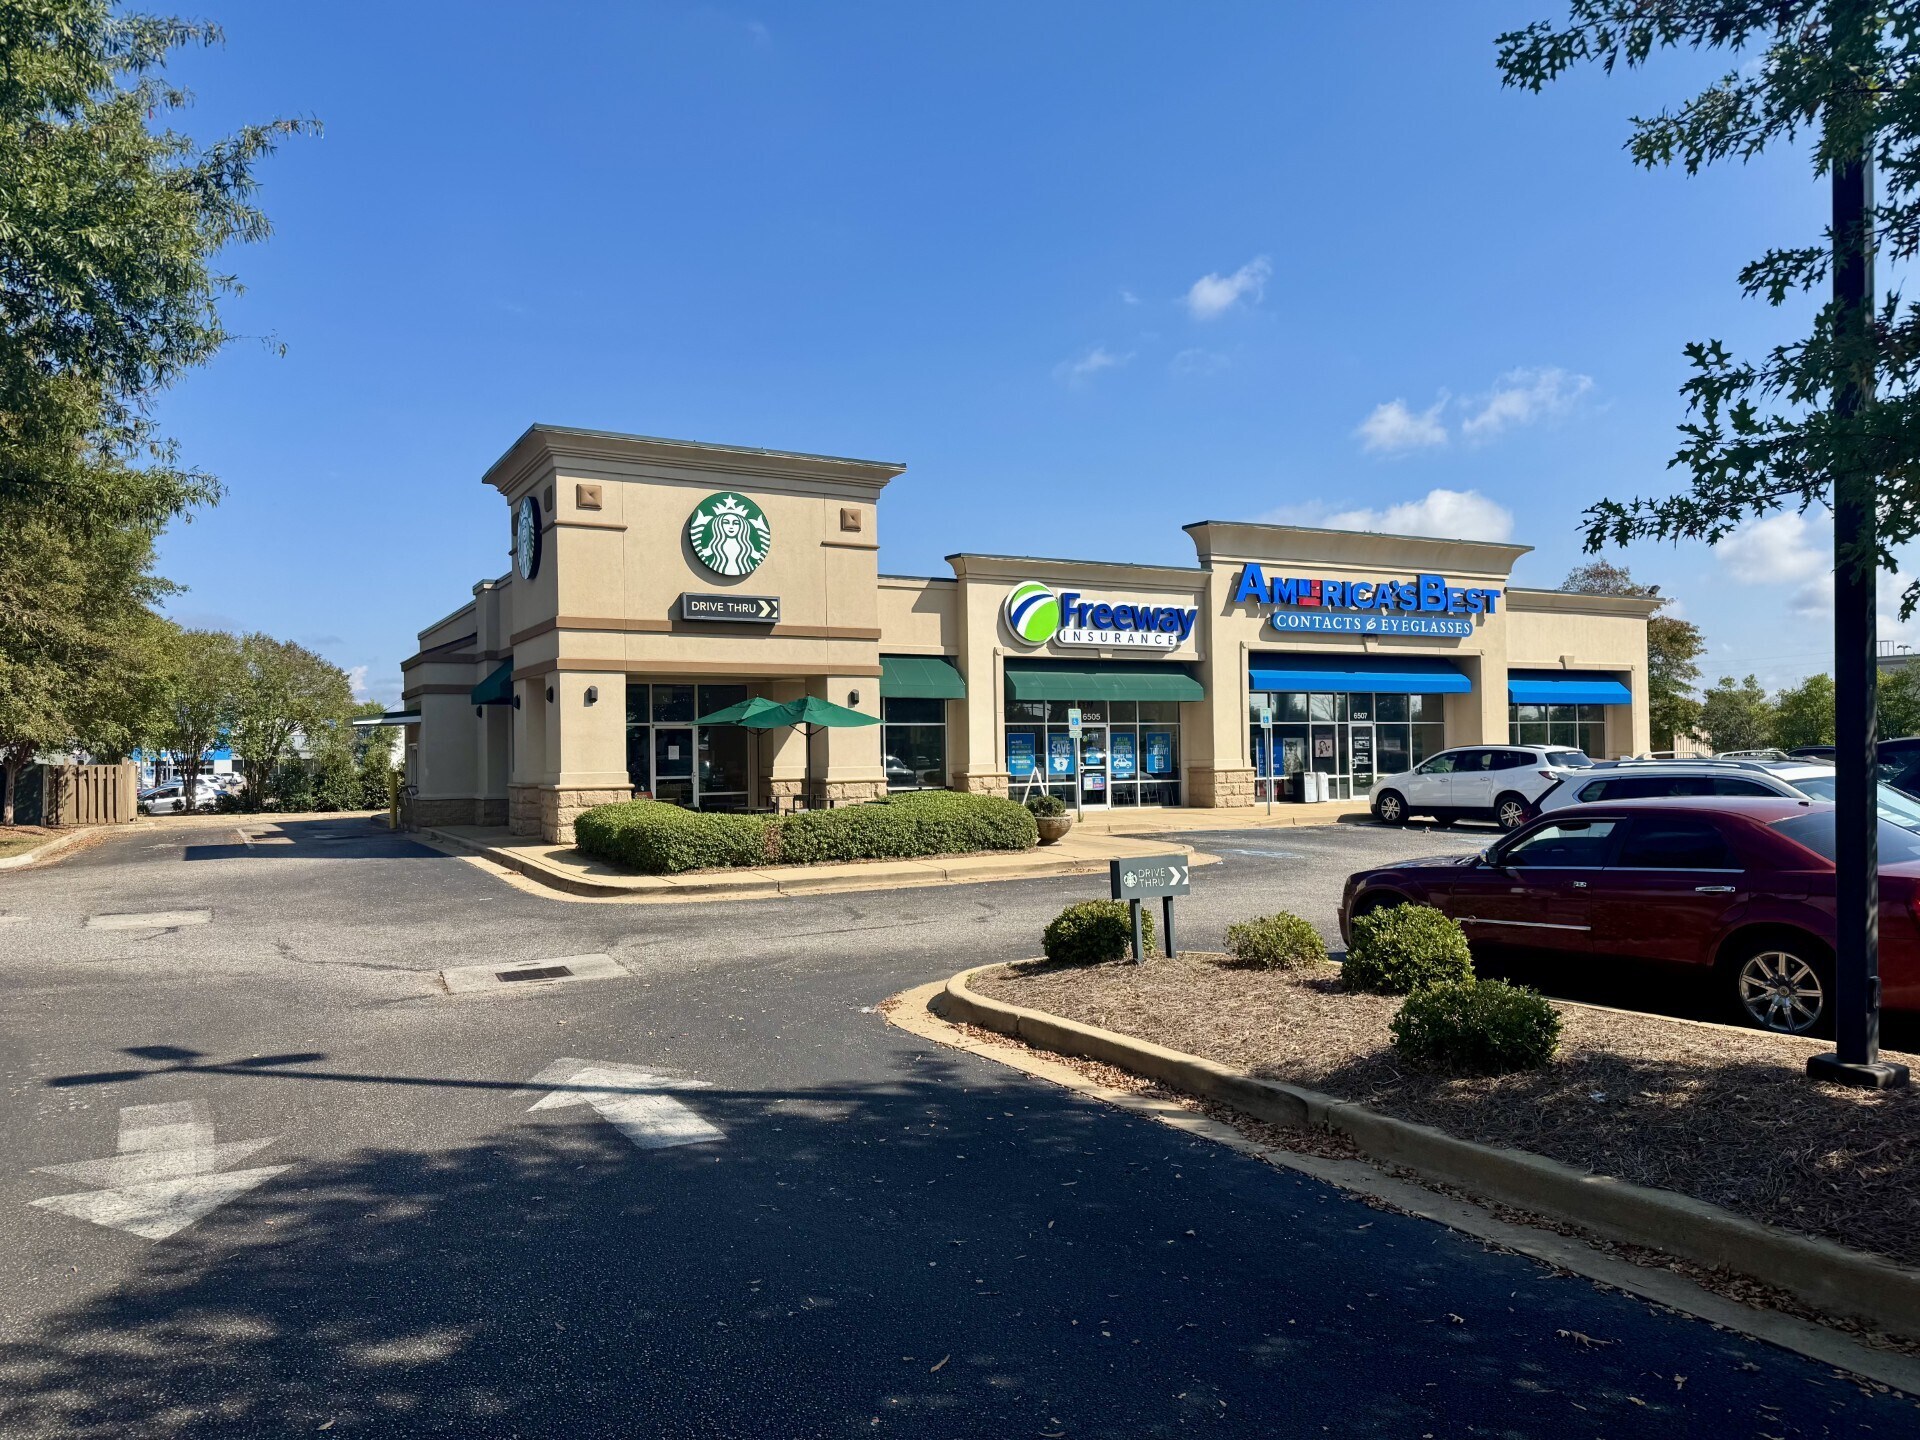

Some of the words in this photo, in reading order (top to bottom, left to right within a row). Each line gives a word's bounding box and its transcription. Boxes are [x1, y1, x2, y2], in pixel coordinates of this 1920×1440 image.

[1234, 563, 1417, 611] AMERICA'S
[1416, 574, 1501, 614] BEST
[691, 601, 724, 612] DRIVE
[727, 602, 756, 613] THRU
[1060, 592, 1198, 642] Freeway
[1276, 614, 1361, 630] CONTACTS
[1381, 619, 1470, 635] EYEGLASSES
[1063, 630, 1174, 645] INSURANCE
[1051, 743, 1071, 754] SAVE
[1138, 867, 1166, 878] DRIVE
[1139, 878, 1165, 887] THRU
